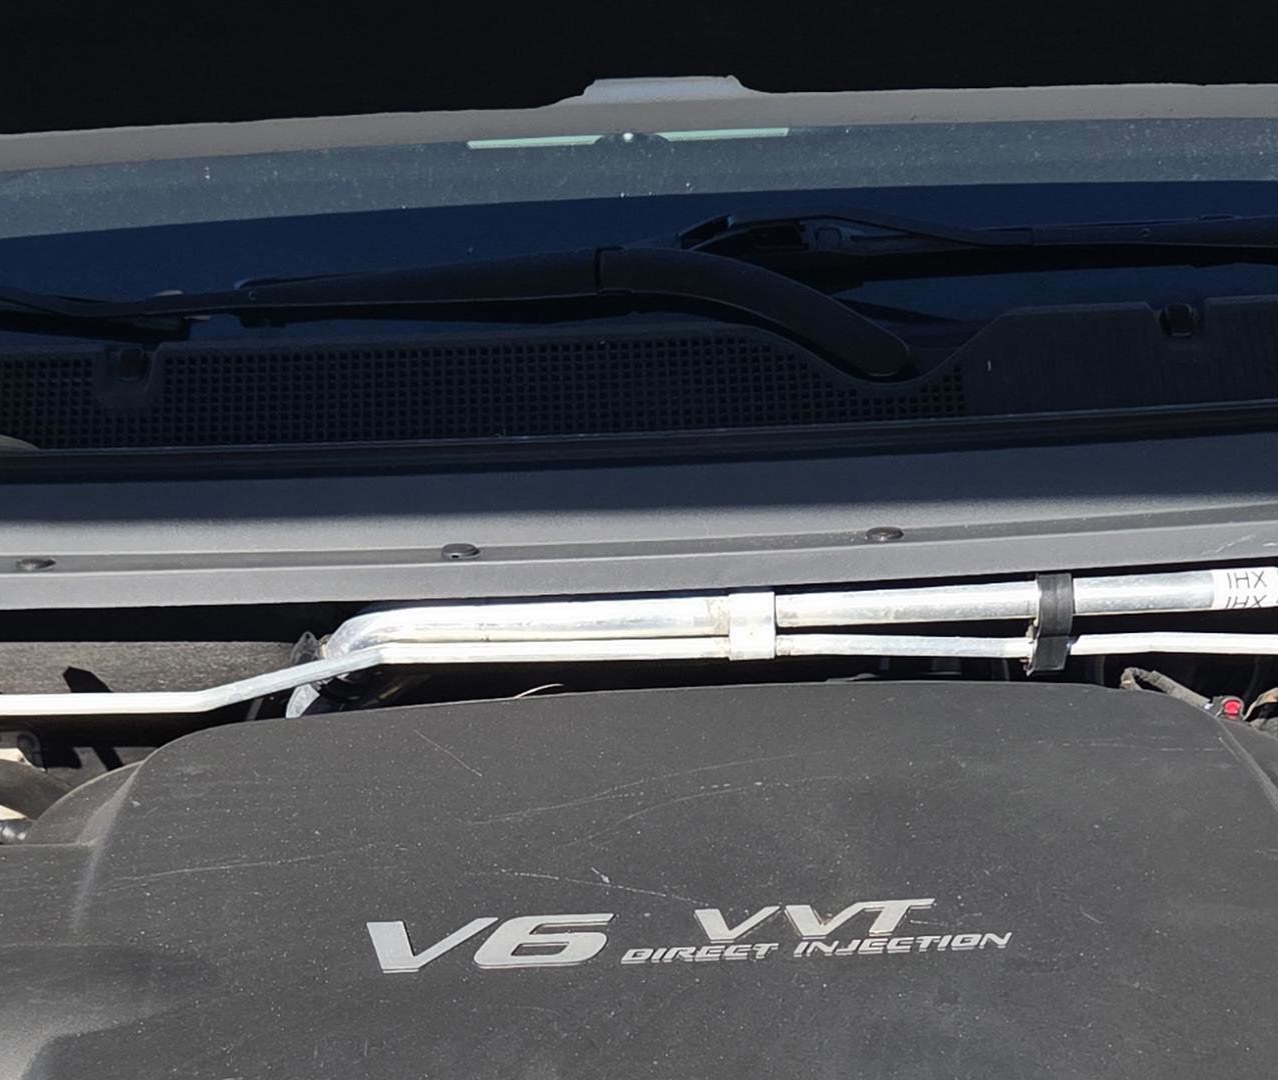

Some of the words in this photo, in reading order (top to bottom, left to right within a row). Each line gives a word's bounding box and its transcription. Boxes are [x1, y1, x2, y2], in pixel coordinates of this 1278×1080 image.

[693, 898, 936, 942] VVT
[366, 912, 615, 974] V6
[621, 942, 779, 965] DIRECT
[793, 931, 1013, 960] INJECTION
